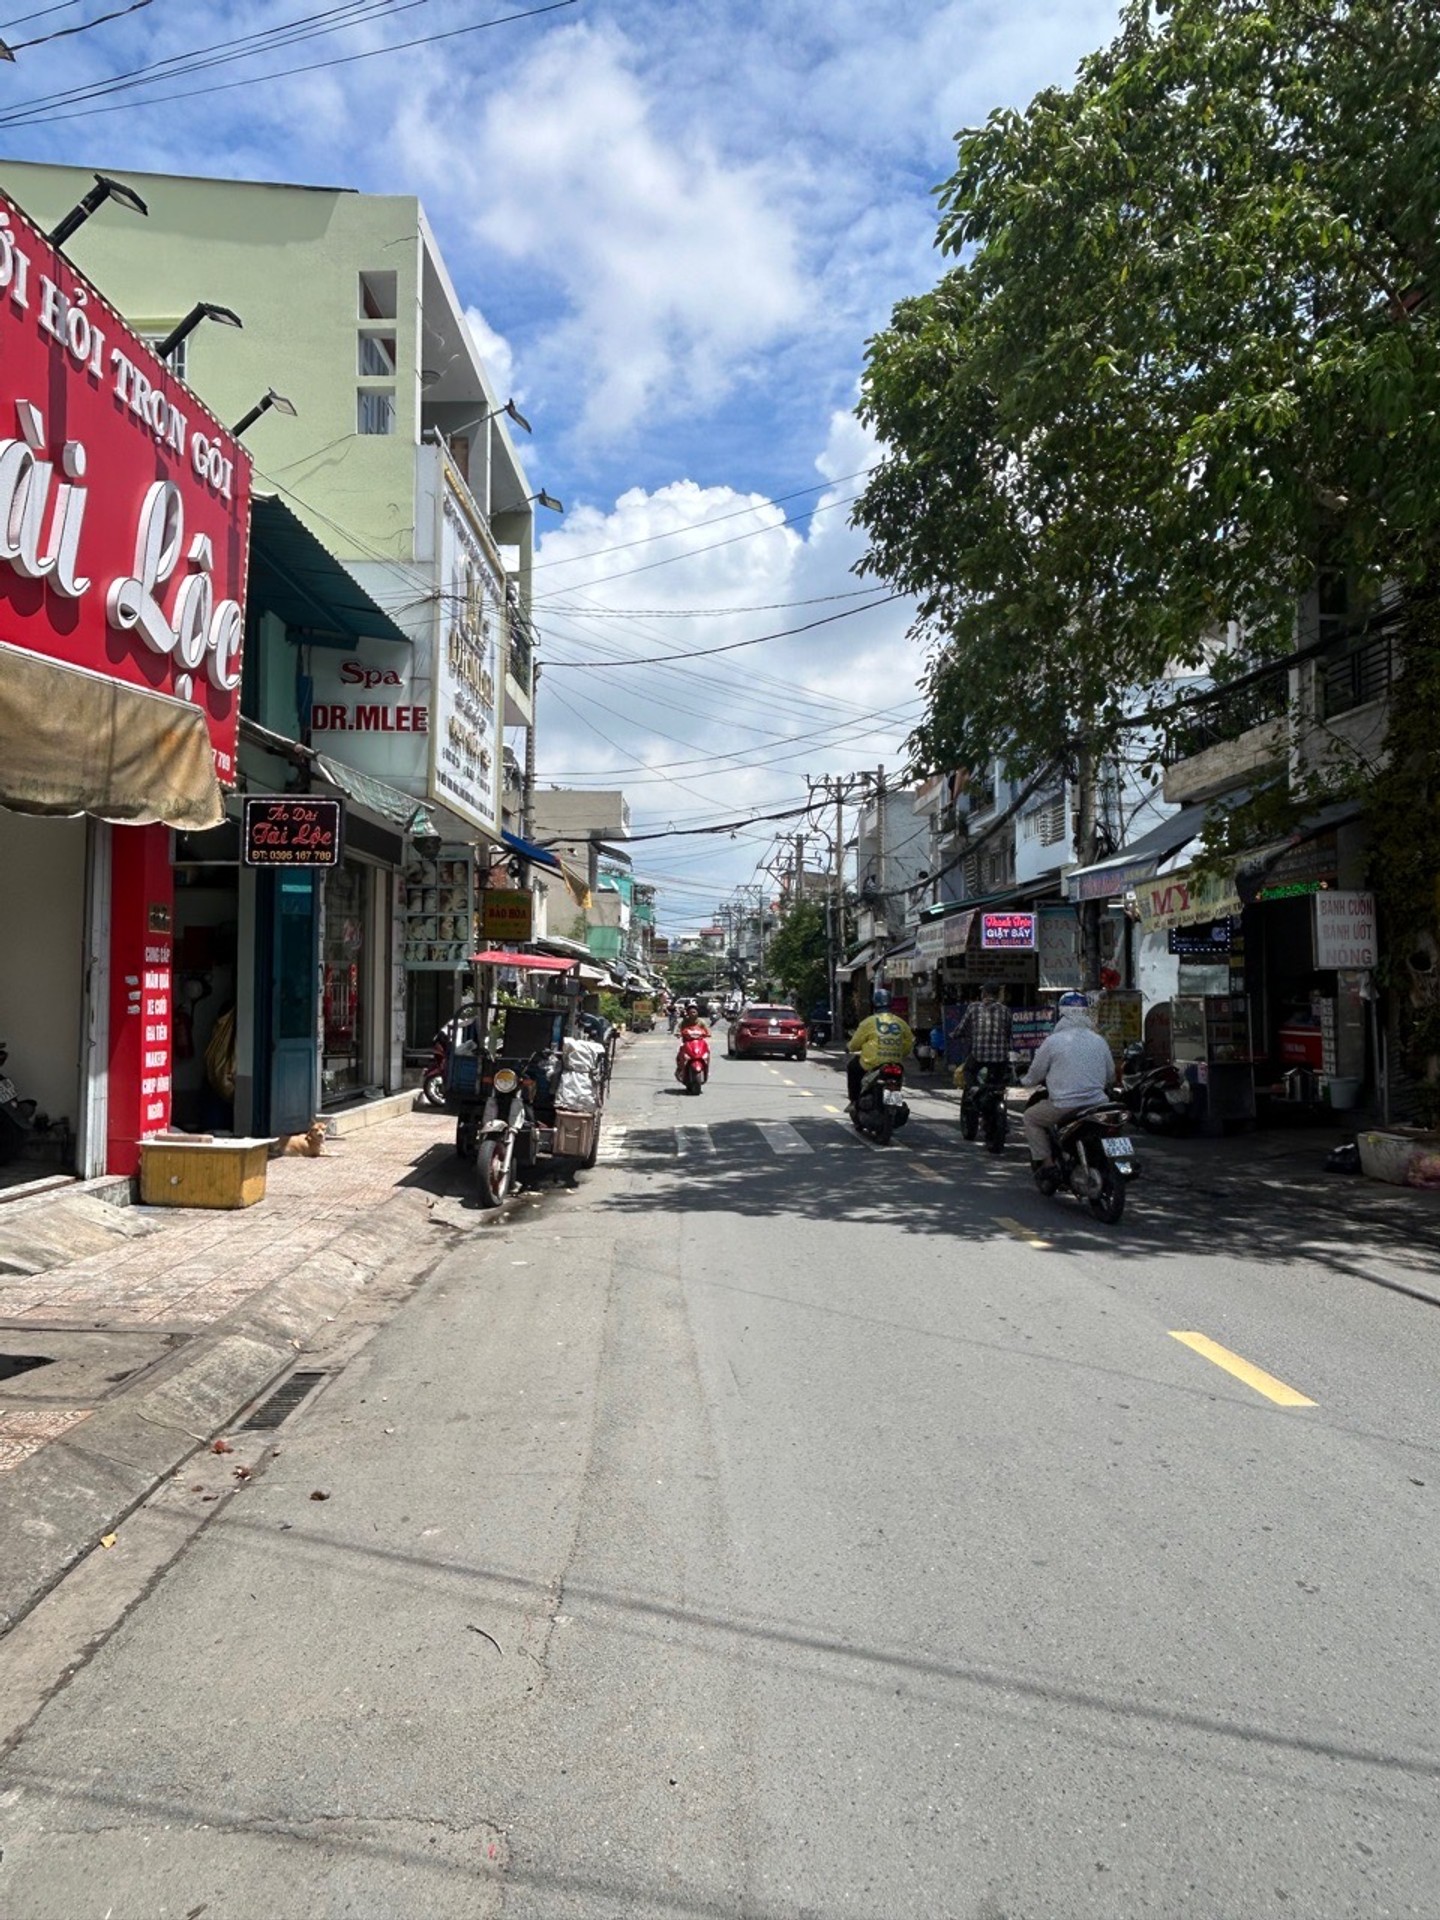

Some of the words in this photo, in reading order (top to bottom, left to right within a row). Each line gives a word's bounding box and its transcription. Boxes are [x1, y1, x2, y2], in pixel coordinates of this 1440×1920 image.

[38, 275, 107, 379] HỎI
[111, 348, 188, 456] TRỌN
[106, 480, 242, 701] Lộc
[340, 662, 403, 689] Spa
[312, 704, 429, 734] DR.MLEE
[252, 822, 288, 845] Tài
[291, 823, 332, 848] Lộc
[1321, 897, 1345, 916] BÁNH
[986, 927, 1009, 939] GIẶT
[1323, 921, 1350, 940] BÁNH
[1353, 919, 1372, 940] ƯỚT
[1326, 944, 1372, 965] NÓNG
[876, 1017, 901, 1034] be
